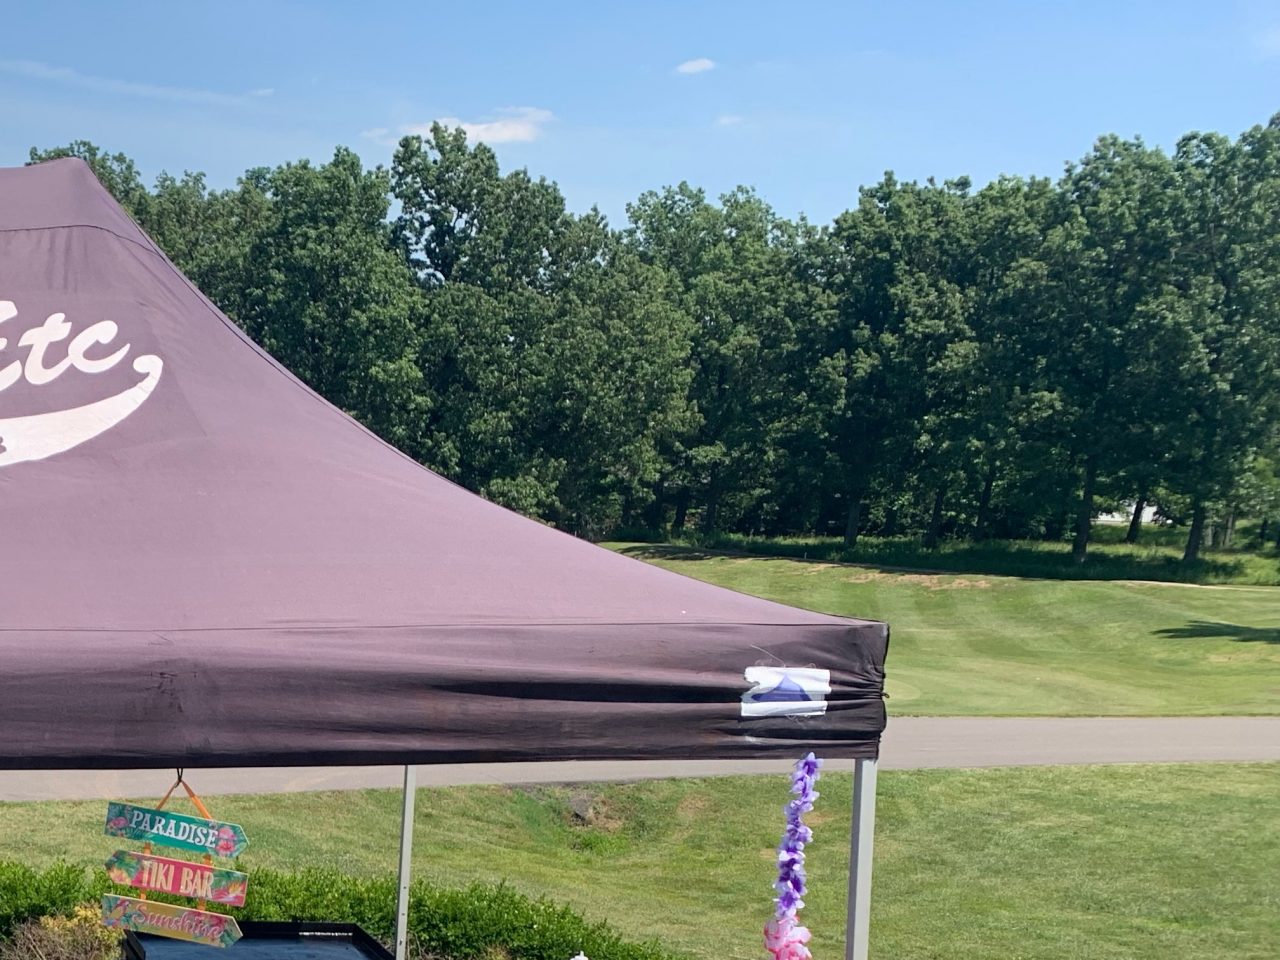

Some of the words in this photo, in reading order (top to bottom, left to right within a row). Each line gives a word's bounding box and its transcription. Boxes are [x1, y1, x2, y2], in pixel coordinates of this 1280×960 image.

[130, 810, 218, 848] PARADISE
[141, 859, 175, 891] TIKI
[180, 867, 214, 898] BAR
[131, 903, 223, 938] Sunshine
